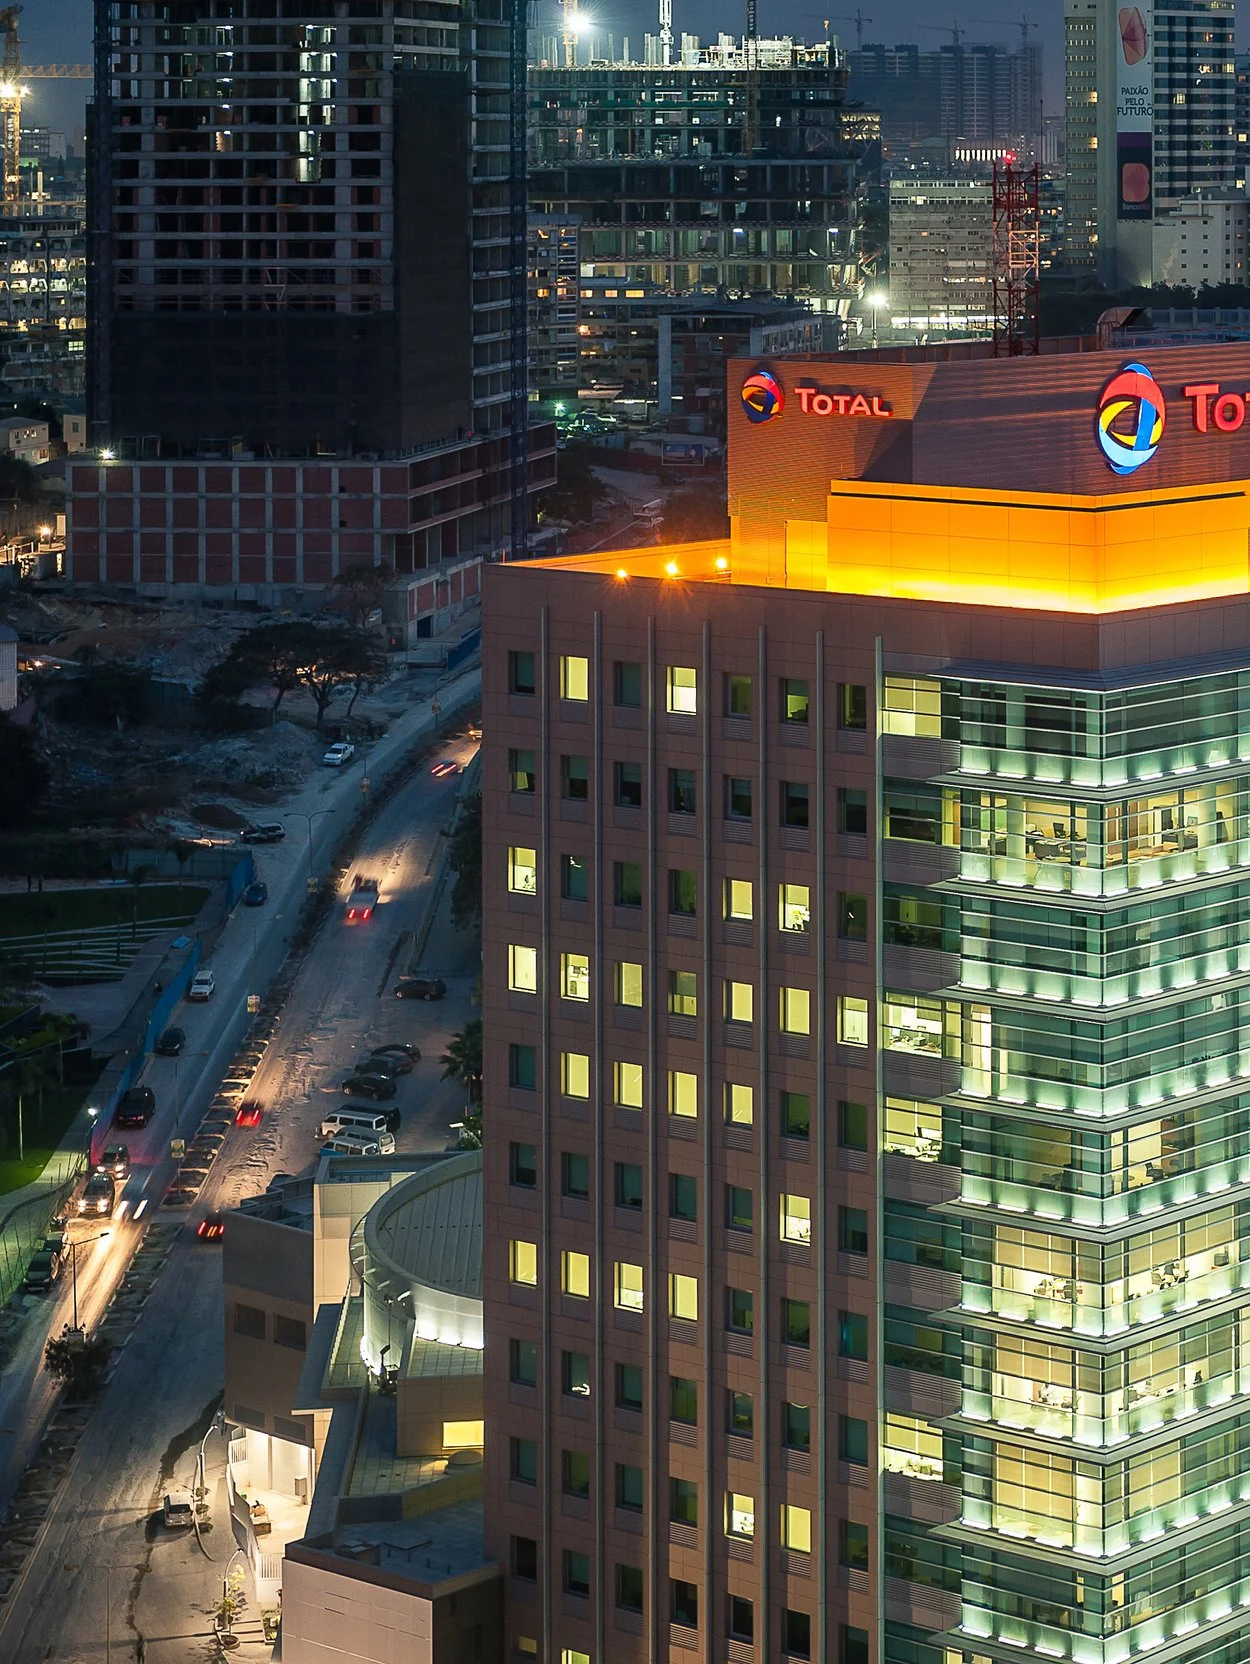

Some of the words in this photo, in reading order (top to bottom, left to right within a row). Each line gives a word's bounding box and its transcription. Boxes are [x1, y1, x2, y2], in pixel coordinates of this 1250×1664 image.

[1121, 85, 1149, 95] PAIXÃO
[1125, 98, 1144, 106] PELO
[1116, 106, 1154, 116] FUTURO
[794, 387, 893, 417] TOTAL
